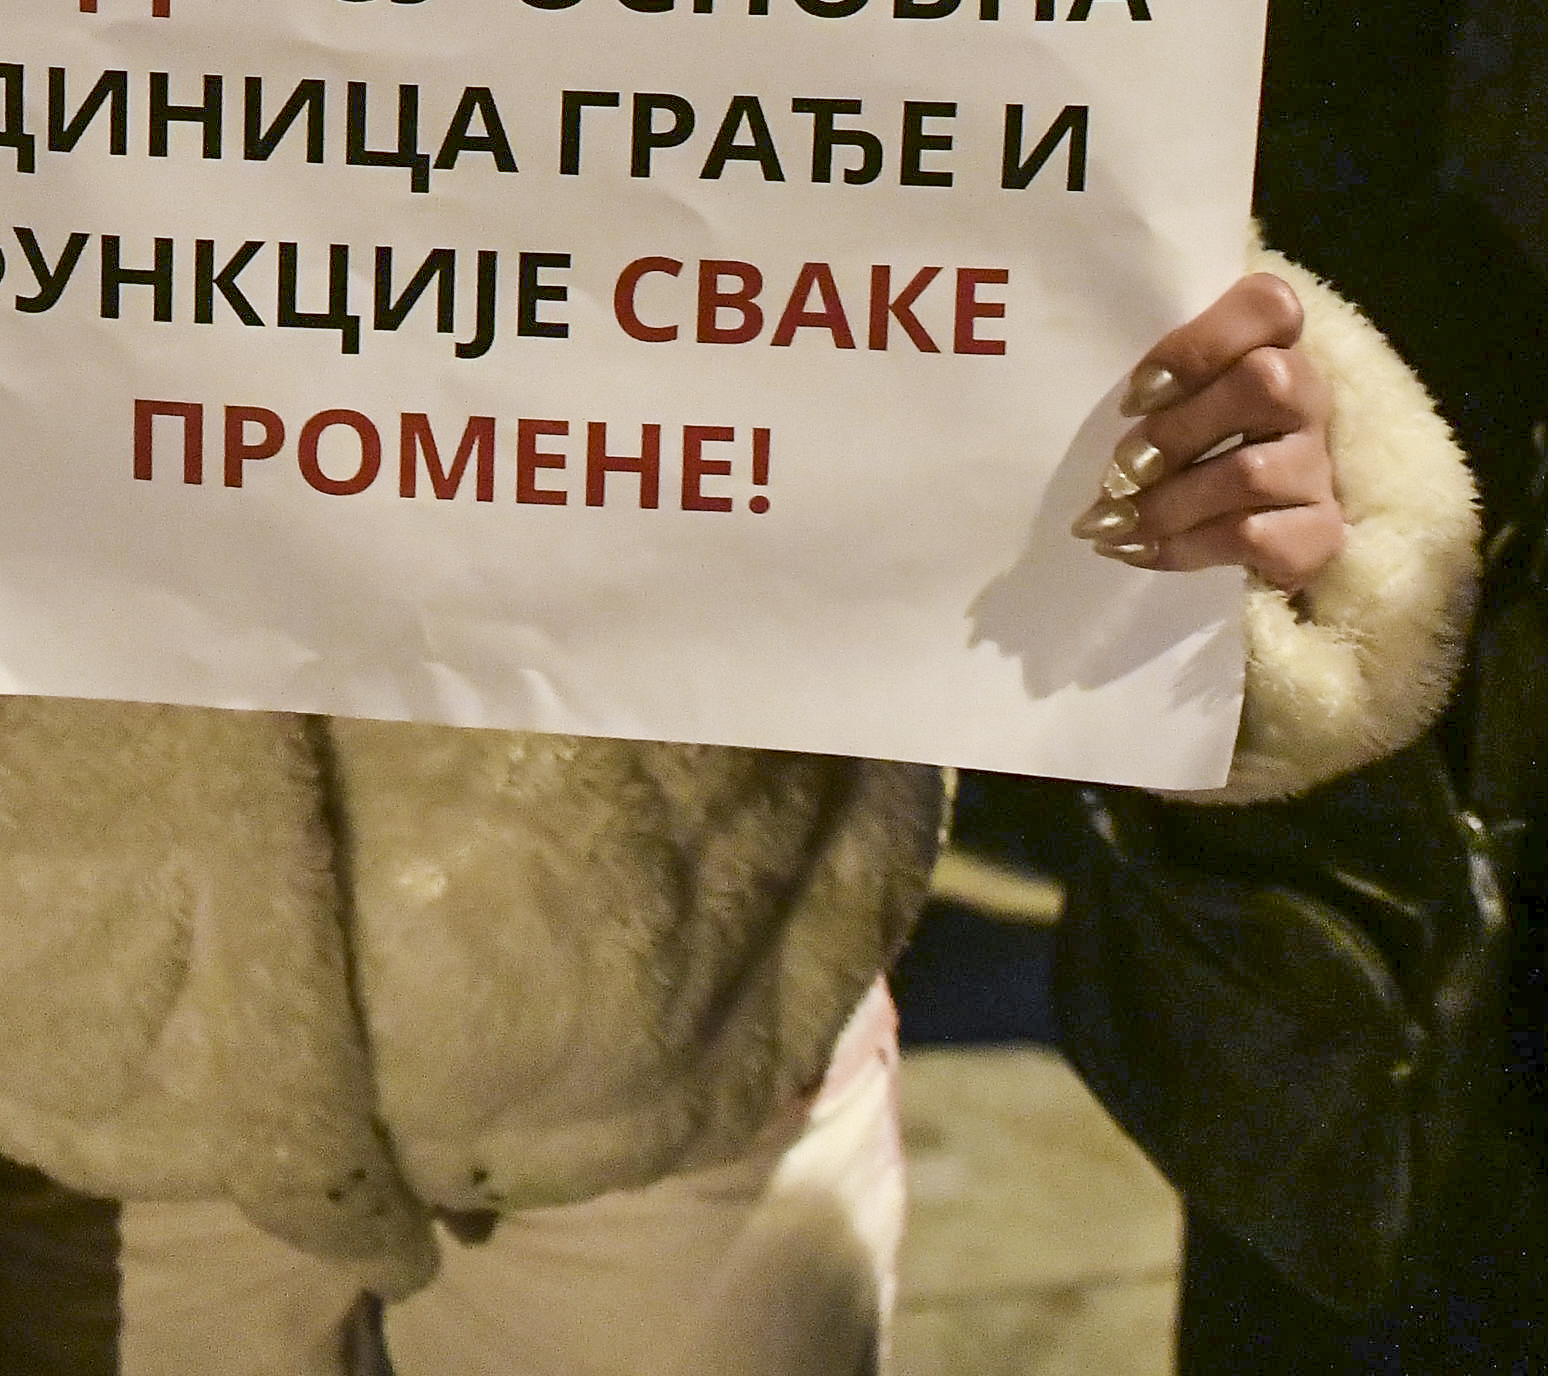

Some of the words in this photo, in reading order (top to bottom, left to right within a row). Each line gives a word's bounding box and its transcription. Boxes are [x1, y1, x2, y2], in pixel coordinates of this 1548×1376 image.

[558, 88, 959, 189] ГРАЂЕ
[999, 102, 1090, 194] И
[612, 255, 1011, 357] СВАКЕ
[132, 397, 772, 516] ПРОМЕНЕ!
